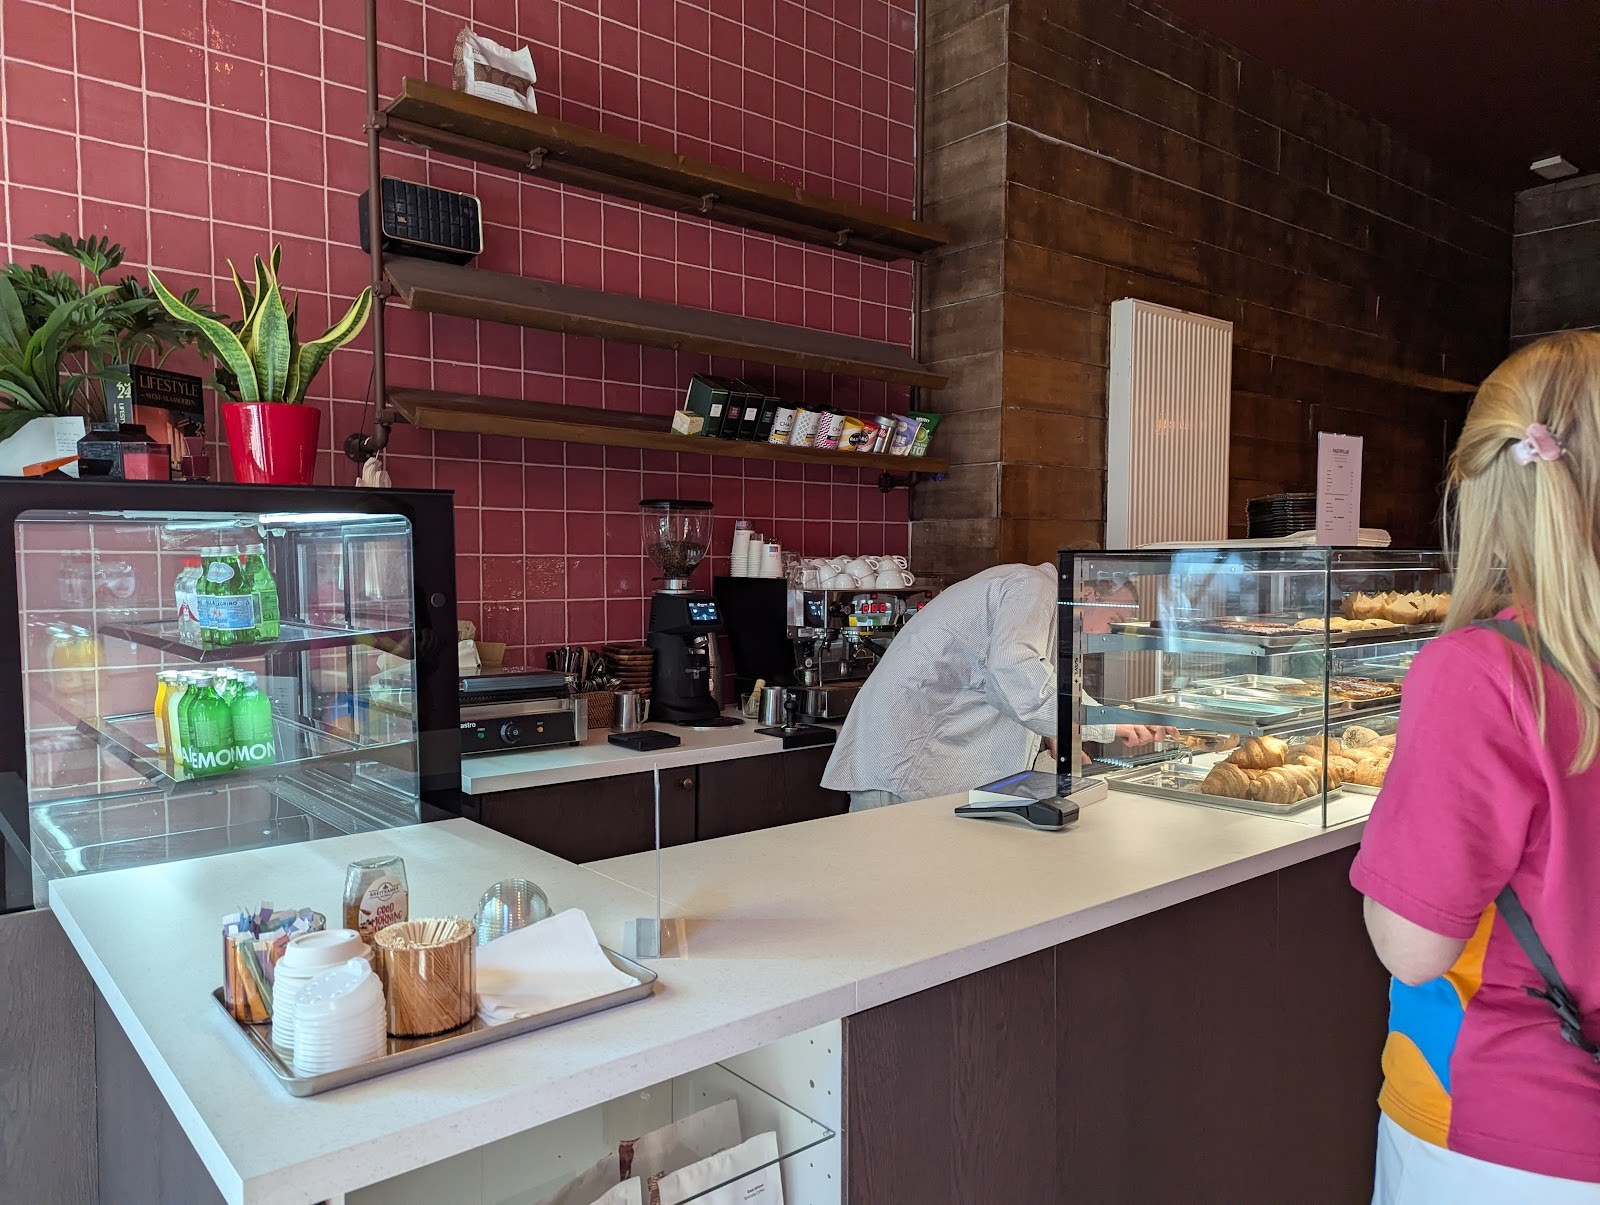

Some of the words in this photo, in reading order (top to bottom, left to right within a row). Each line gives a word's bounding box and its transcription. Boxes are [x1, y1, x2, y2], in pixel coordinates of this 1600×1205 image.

[117, 385, 132, 399] 24
[140, 375, 199, 398] LIFESTYLE
[376, 902, 394, 916] GOOD
[371, 910, 402, 928] MORNING
